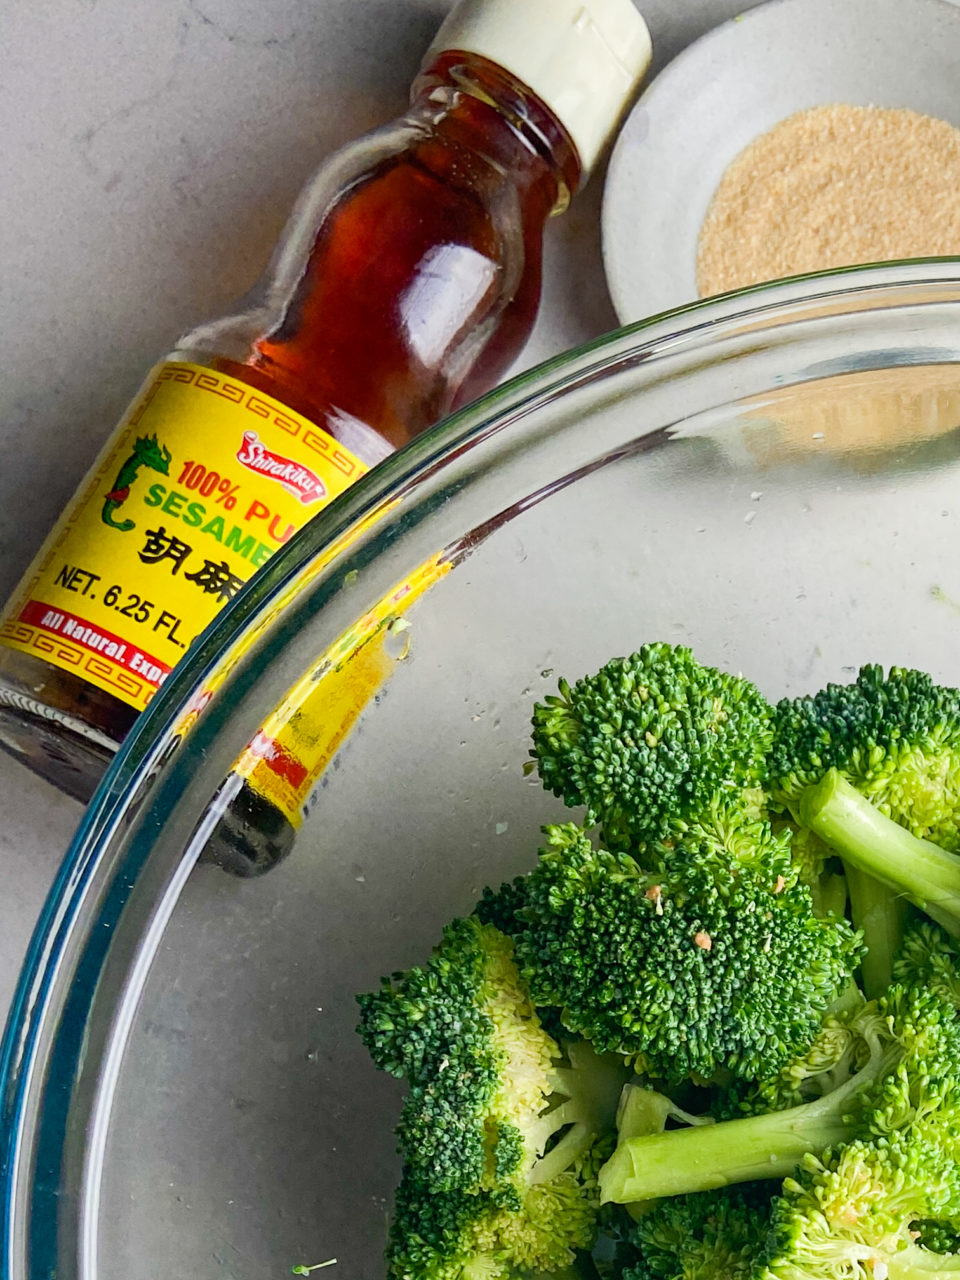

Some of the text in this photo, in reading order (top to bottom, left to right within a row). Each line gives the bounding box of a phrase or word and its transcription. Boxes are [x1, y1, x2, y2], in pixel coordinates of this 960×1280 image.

[177, 460, 240, 511] 100%
[238, 442, 315, 491] Shirakiku
[53, 564, 186, 649] NET. 6.25 FL.
[41, 610, 65, 631] All
[62, 617, 126, 663] Natural.
